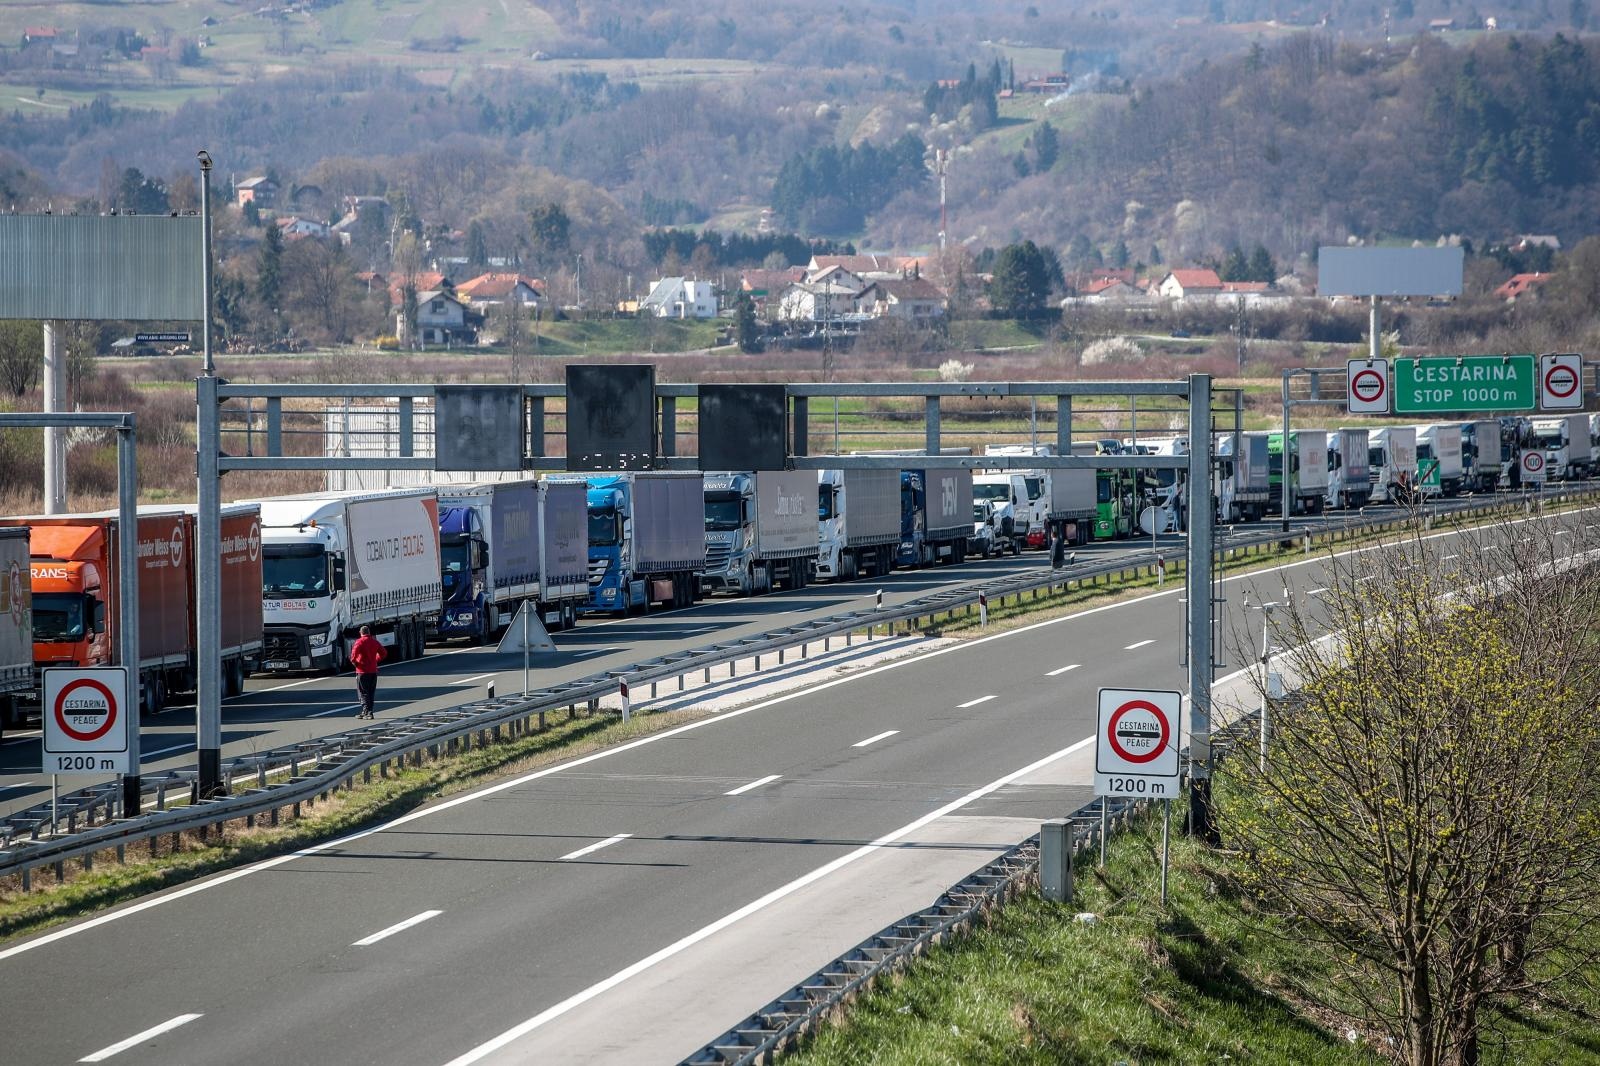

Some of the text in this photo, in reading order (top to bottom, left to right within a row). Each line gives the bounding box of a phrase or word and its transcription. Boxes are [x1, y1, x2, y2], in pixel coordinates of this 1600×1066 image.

[1413, 365, 1518, 382] CESTARINA
[1413, 388, 1517, 403] STOP 1000 m
[64, 699, 106, 709] CESTARINA
[73, 715, 98, 725] PEAGE
[1119, 721, 1160, 731] CESTARINA
[1126, 738, 1151, 748] PEAGE
[57, 756, 114, 770] 1200 m
[1108, 778, 1165, 794] 1200 m
